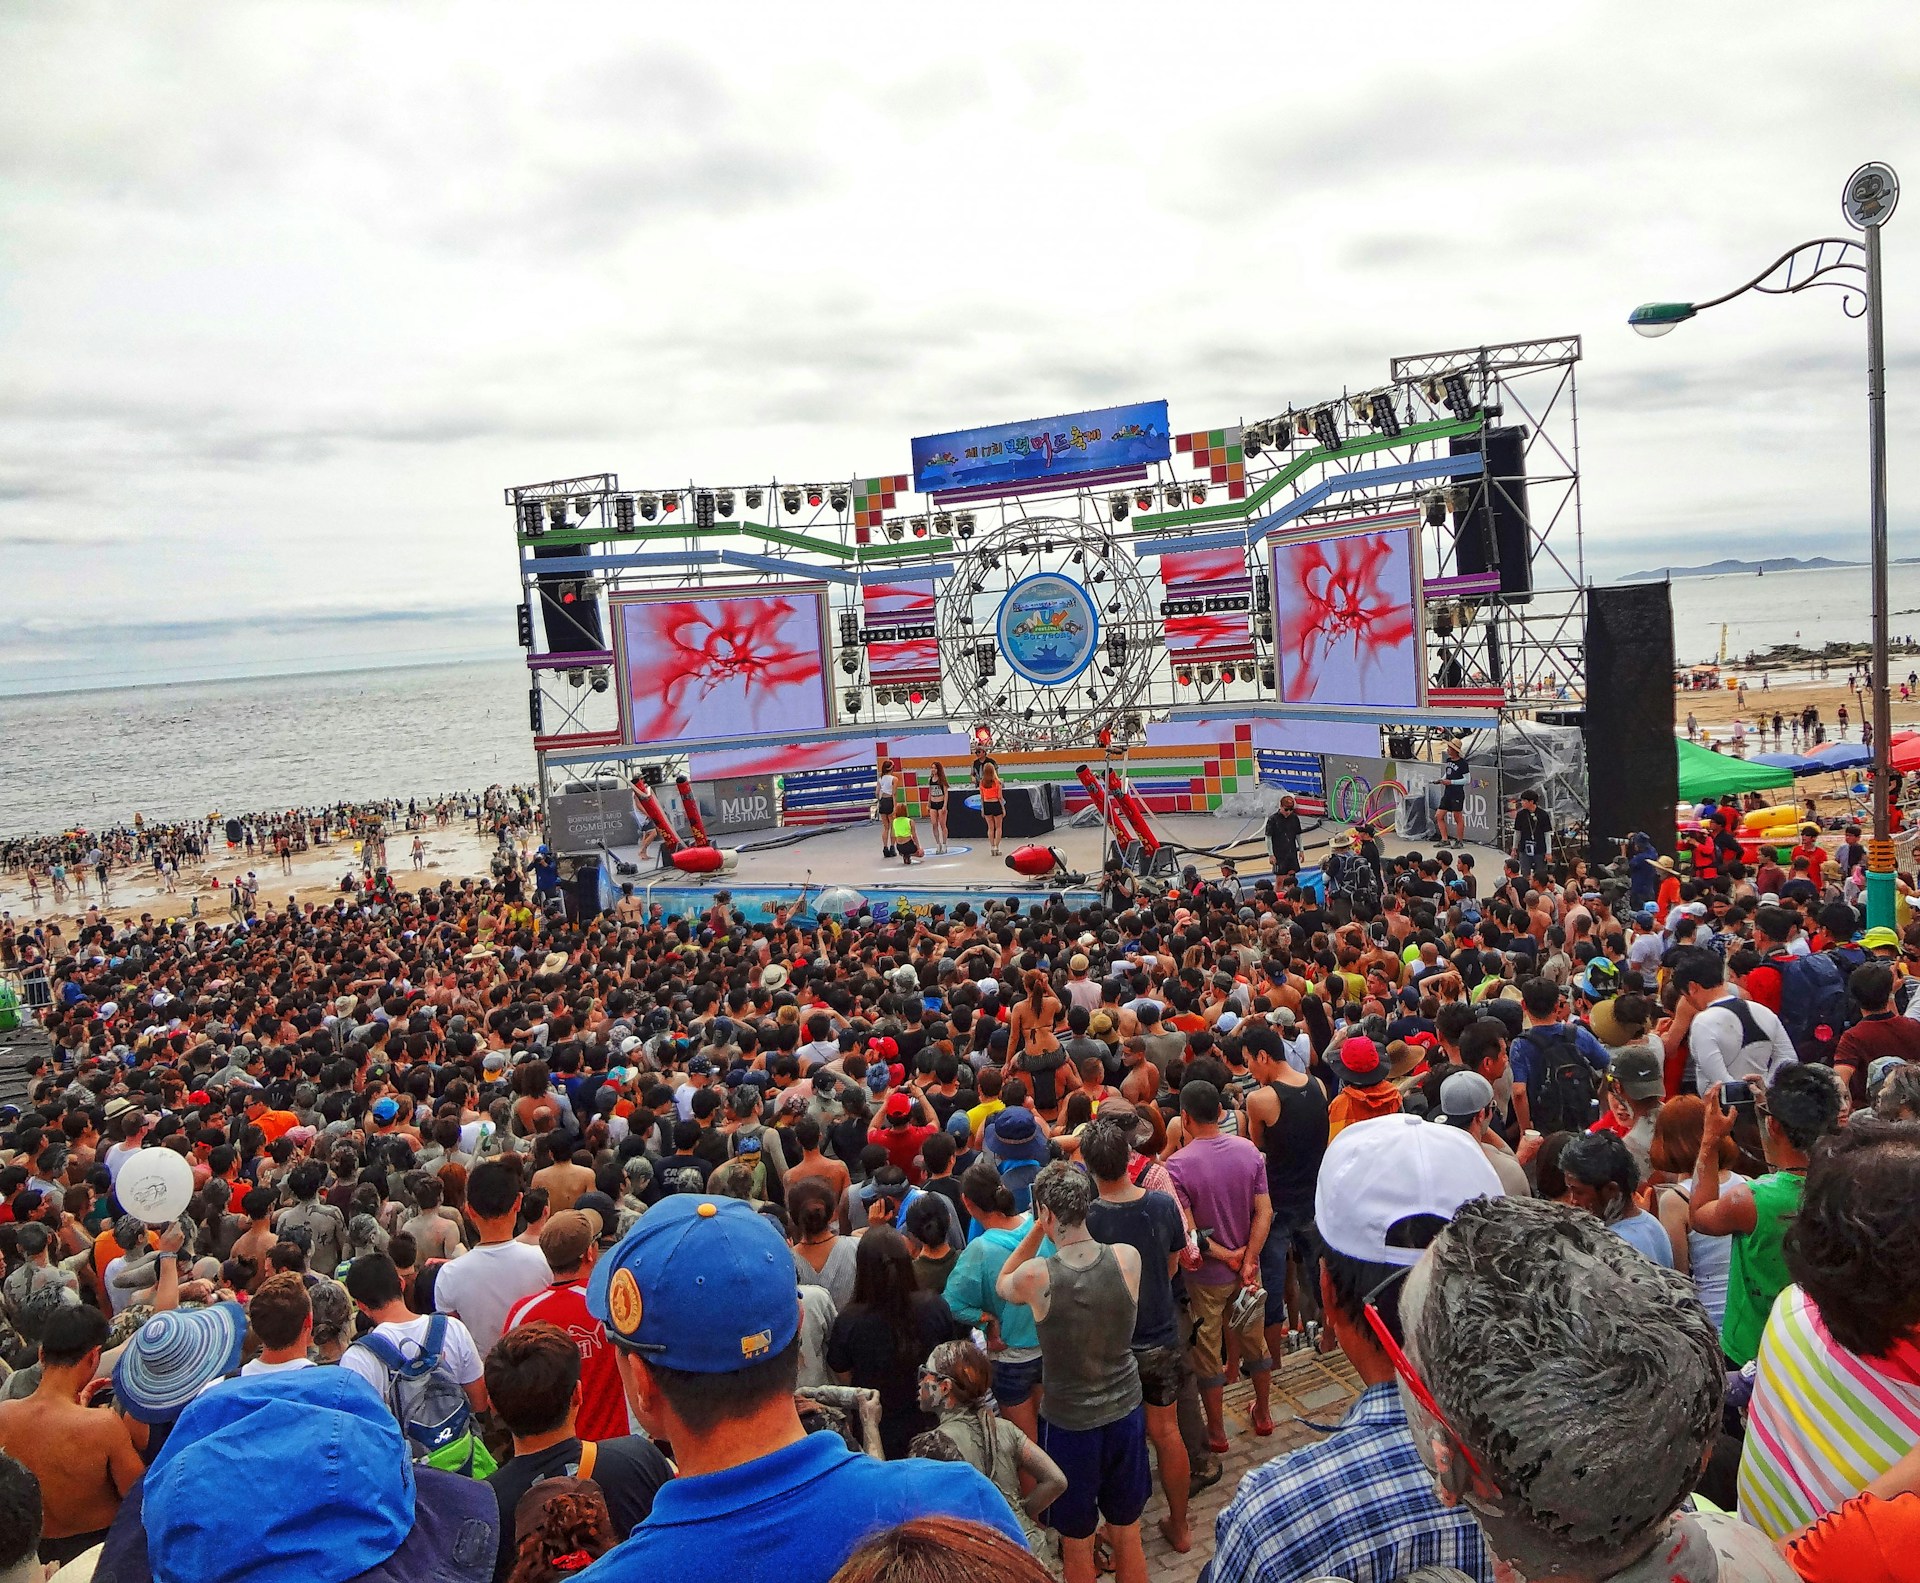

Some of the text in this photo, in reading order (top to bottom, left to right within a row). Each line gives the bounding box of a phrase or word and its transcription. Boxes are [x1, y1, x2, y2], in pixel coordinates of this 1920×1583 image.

[722, 795, 768, 815] MUD
[1463, 794, 1487, 816] UD
[722, 809, 772, 824] FESTIVAL
[568, 819, 623, 833] COSMETICS
